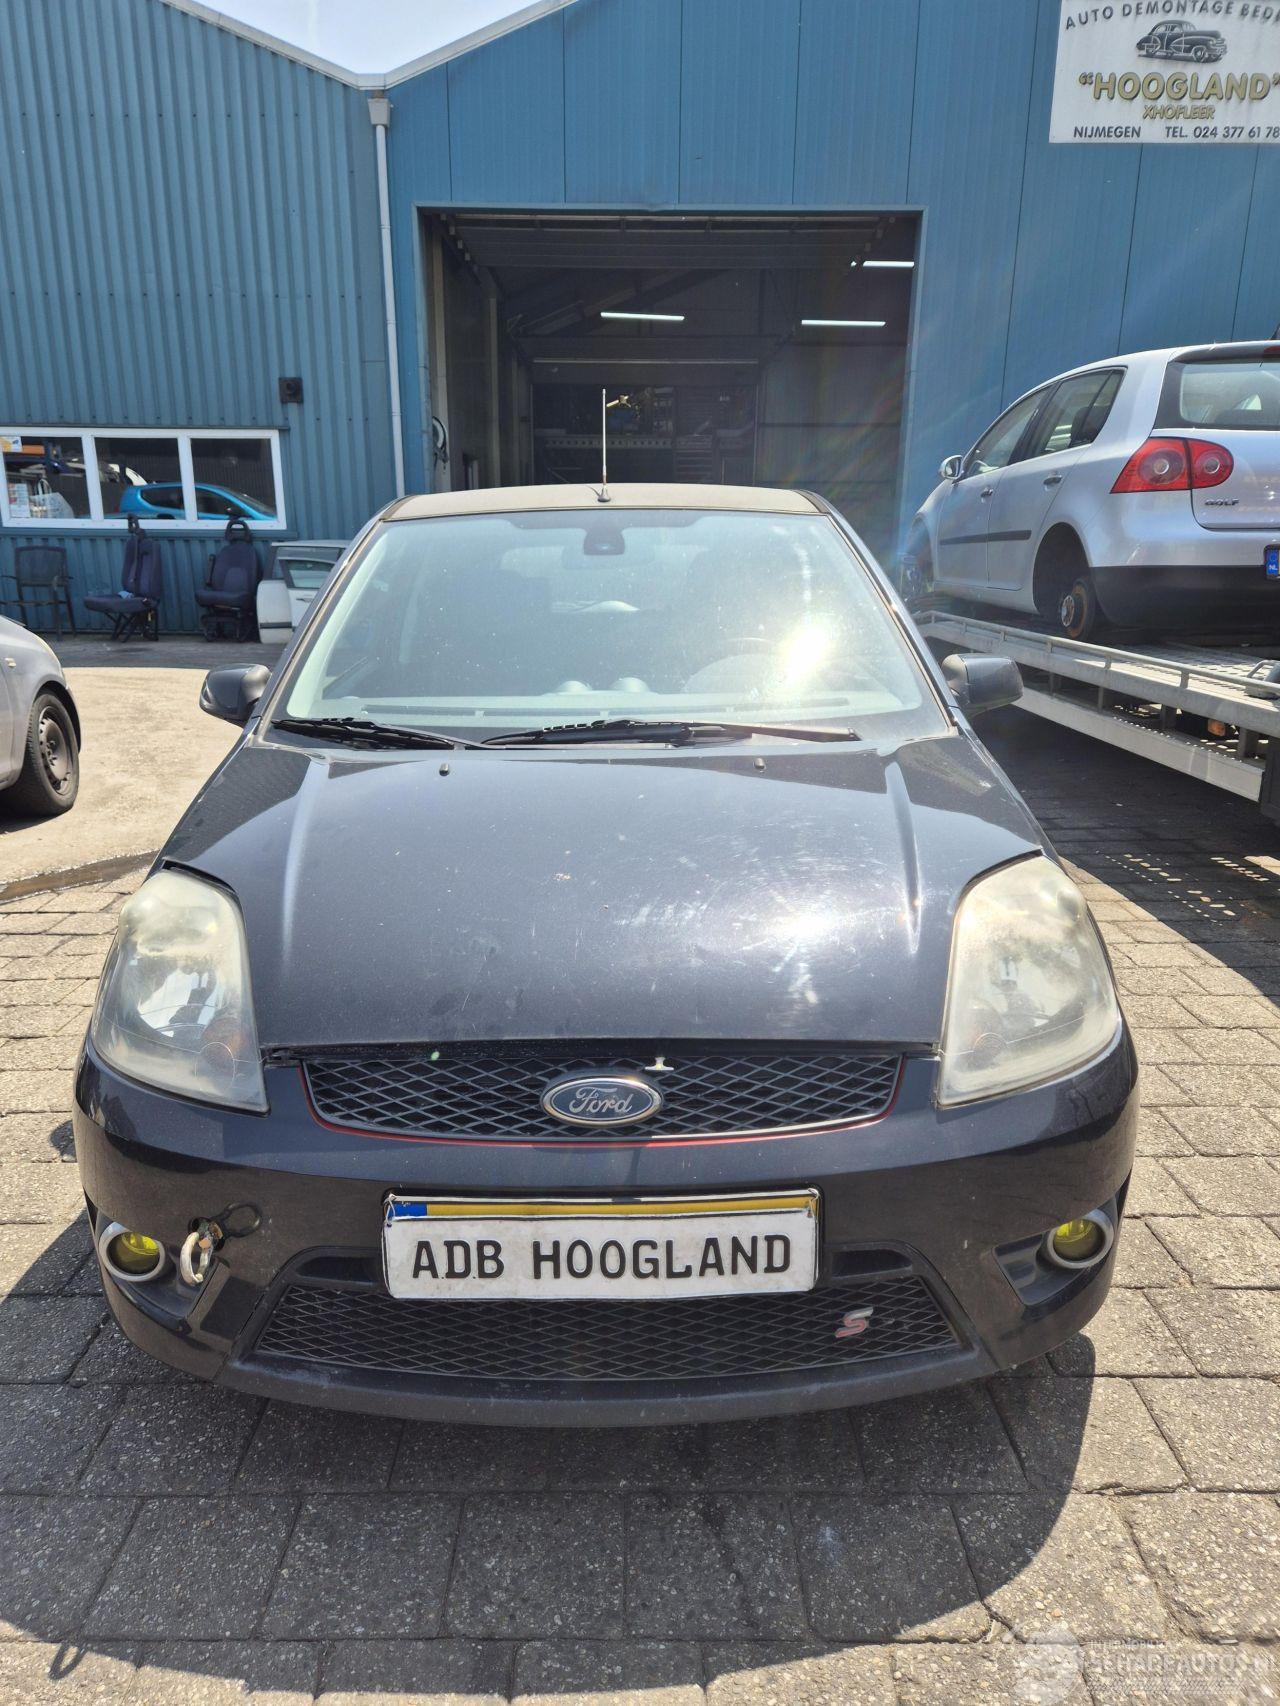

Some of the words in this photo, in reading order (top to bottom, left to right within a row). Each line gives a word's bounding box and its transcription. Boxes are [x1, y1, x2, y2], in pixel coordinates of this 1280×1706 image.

[1066, 6, 1114, 30] AUTO
[1121, 0, 1234, 17] DEMONTAGE
[1073, 126, 1142, 138] NIJMEGEN
[1165, 126, 1188, 138] TEL.
[1193, 126, 1218, 139] 024
[1222, 126, 1245, 139] 377
[1248, 126, 1261, 138] 61
[1265, 126, 1280, 138] 78
[1204, 498, 1240, 507] GOLF
[568, 1086, 634, 1113] Ford
[532, 1234, 791, 1280] HOOGLAND
